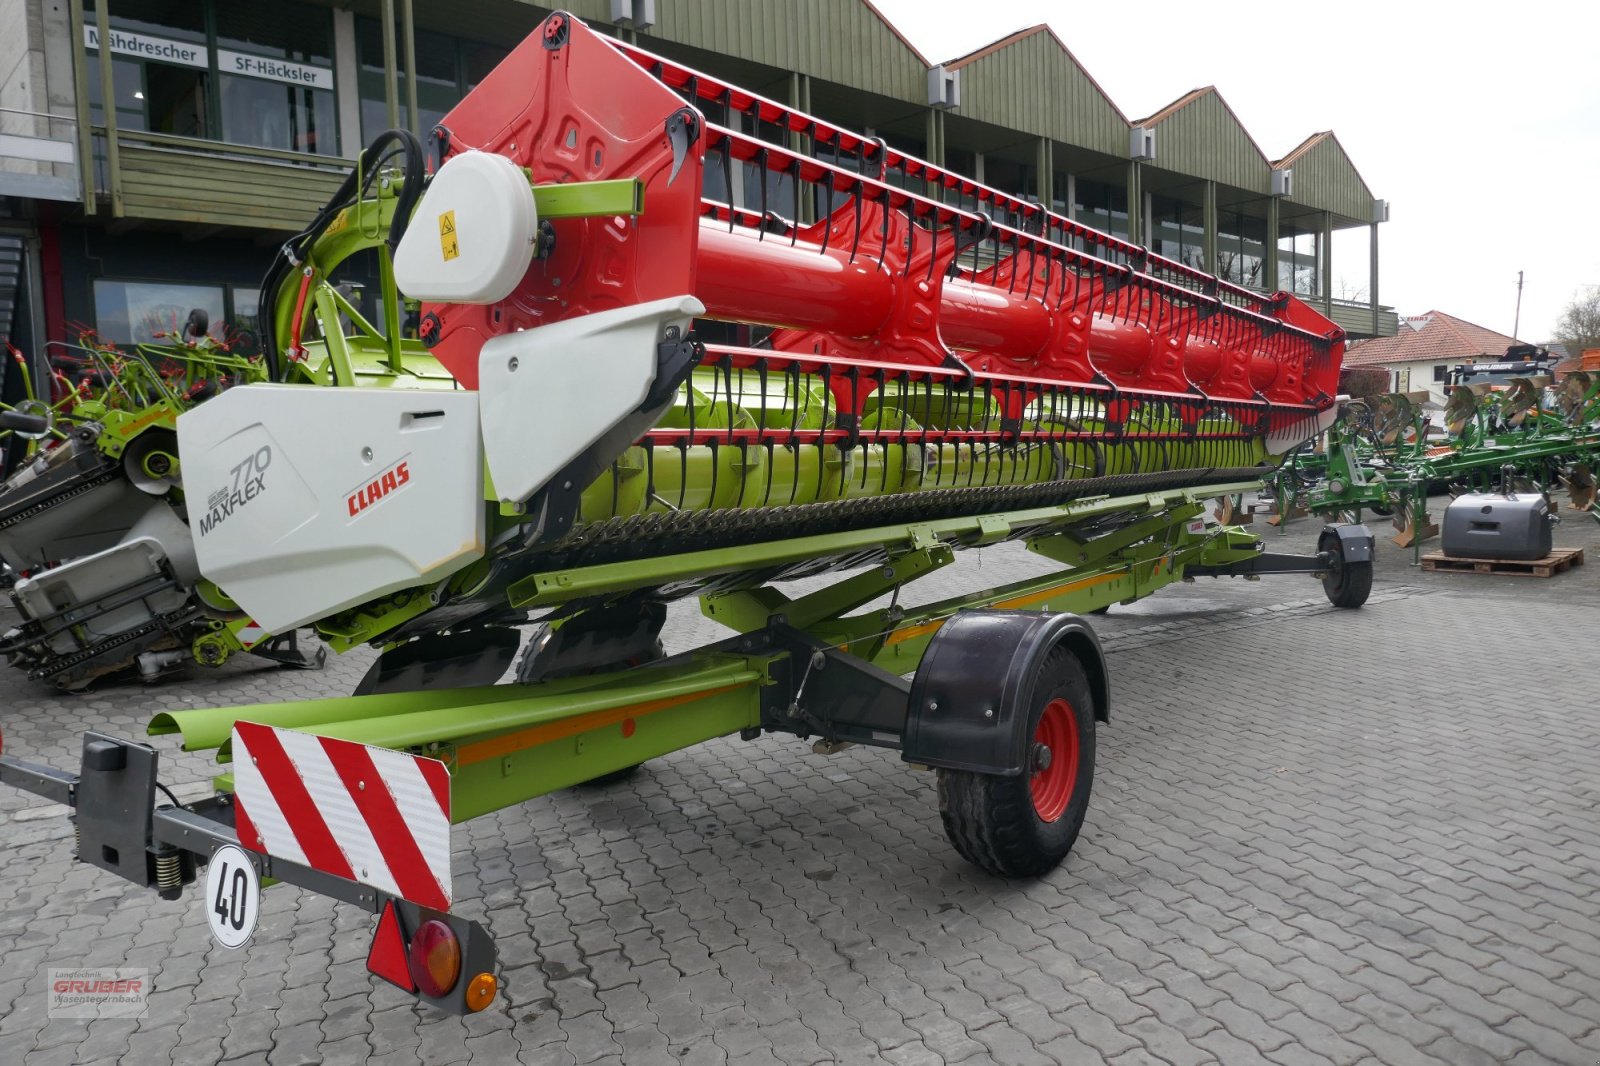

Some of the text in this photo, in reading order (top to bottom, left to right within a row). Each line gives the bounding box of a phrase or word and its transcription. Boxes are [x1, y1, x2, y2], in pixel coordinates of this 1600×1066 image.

[89, 30, 197, 62] Mähdrescher
[235, 56, 317, 83] SF-Häcksler
[230, 445, 271, 492] 770
[348, 461, 410, 517] CLAAS
[199, 473, 266, 537] MAXFLEX
[214, 861, 248, 931] 40
